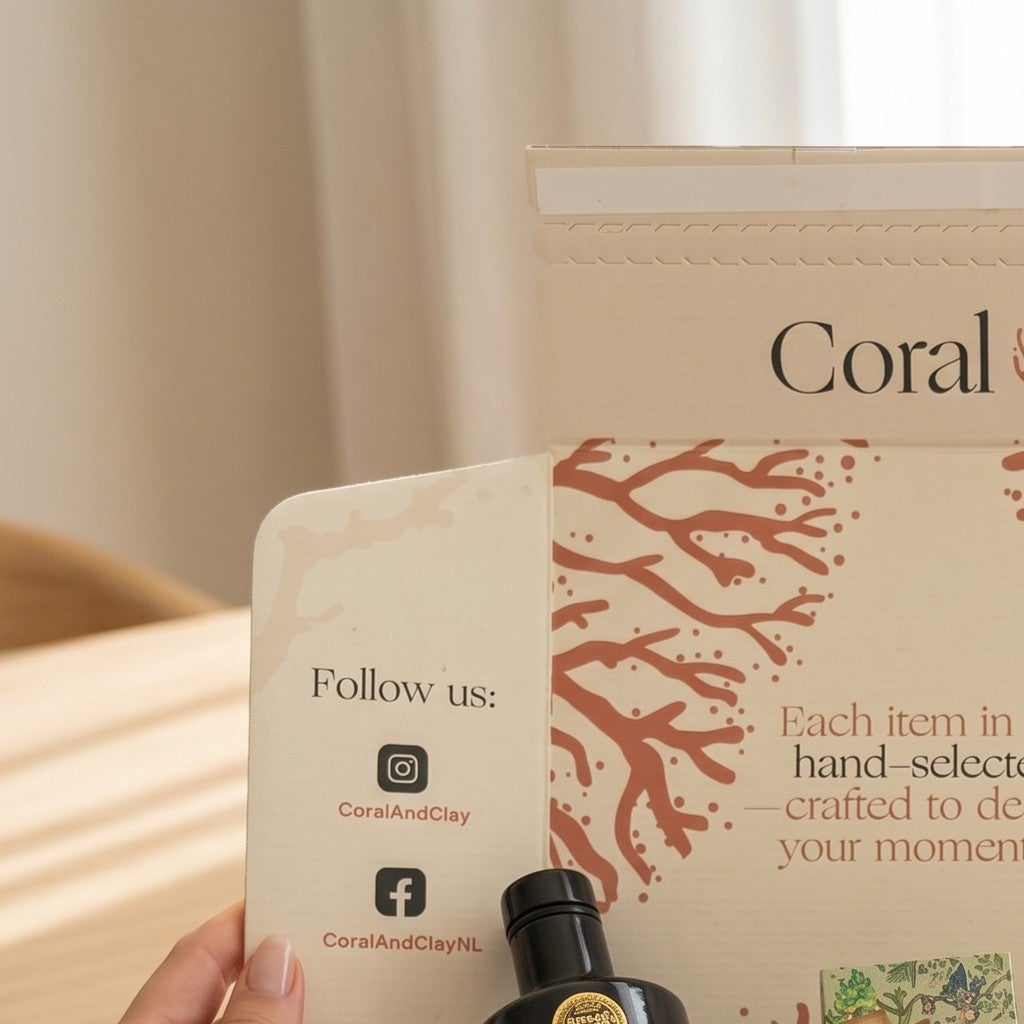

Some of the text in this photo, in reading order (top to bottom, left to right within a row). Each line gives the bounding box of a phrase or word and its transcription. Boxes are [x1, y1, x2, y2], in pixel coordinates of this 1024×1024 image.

[770, 309, 993, 396] Coral
[311, 668, 497, 709] Follow us:
[780, 702, 873, 738] Each
[886, 703, 966, 738] item
[980, 703, 1014, 738] in
[338, 801, 471, 827] CoralAndClay
[927, 791, 962, 821] to
[777, 835, 861, 870] your
[322, 932, 483, 955] CoralAndClayNL
